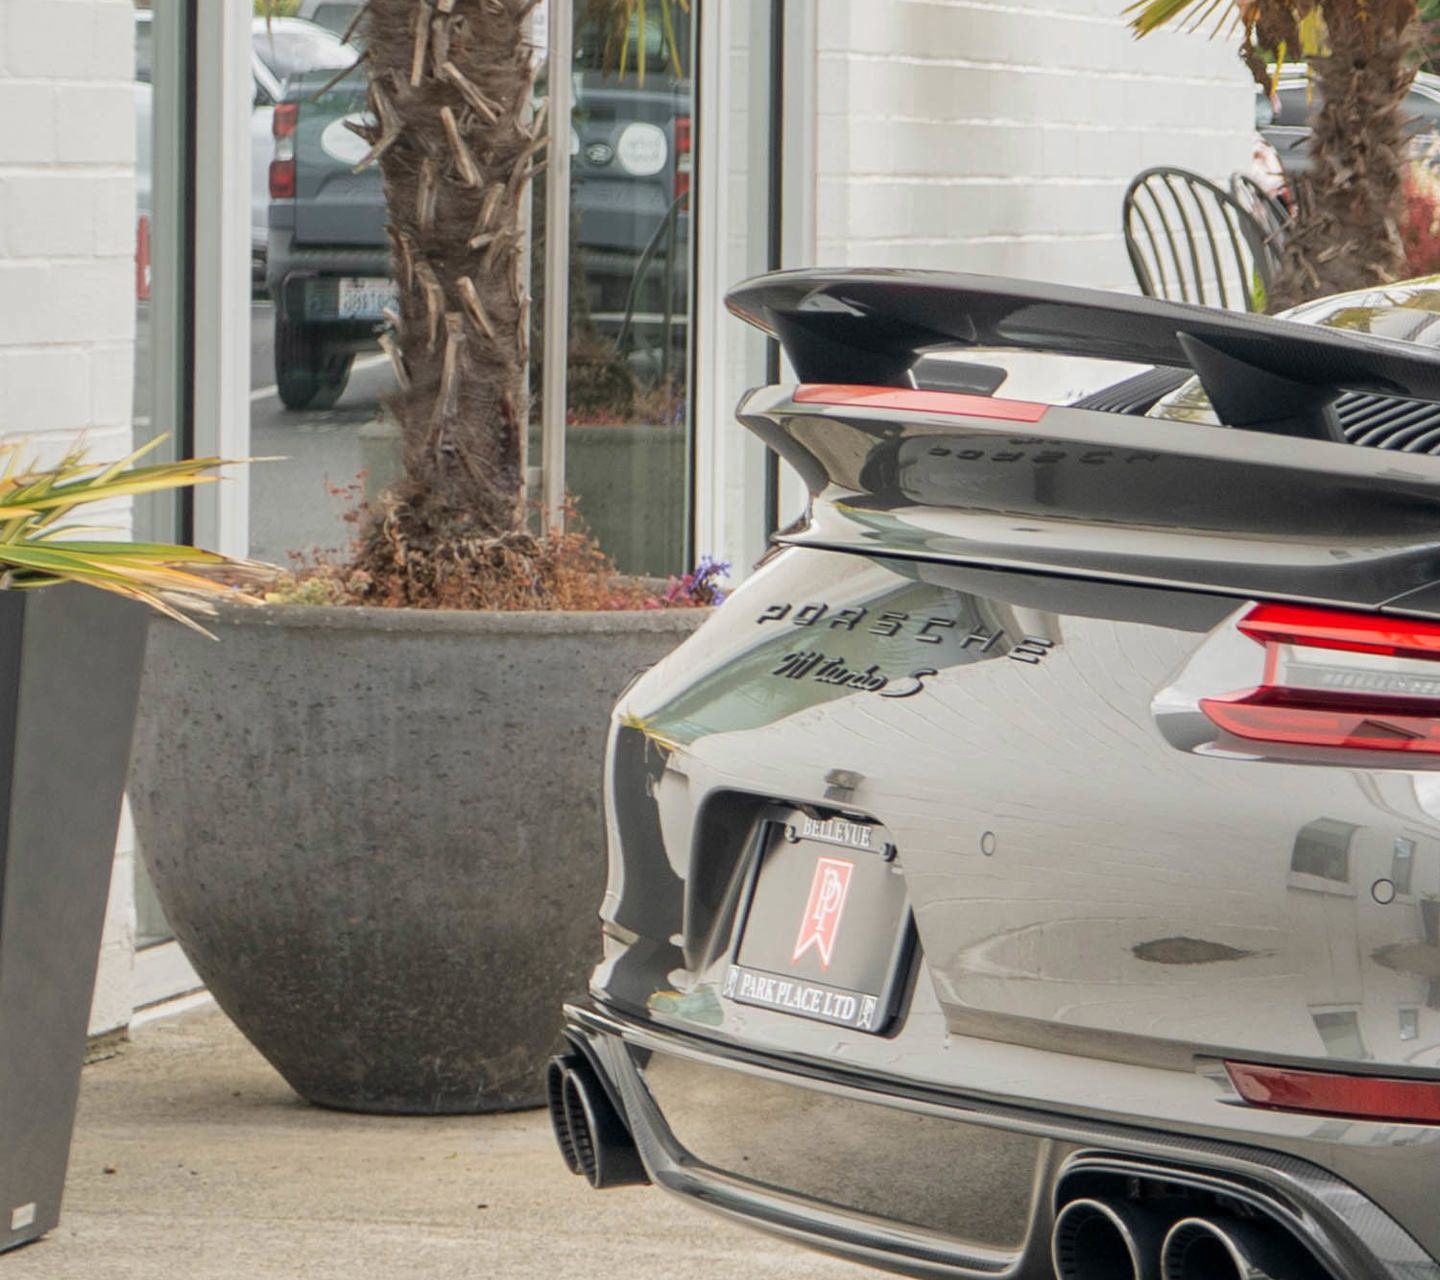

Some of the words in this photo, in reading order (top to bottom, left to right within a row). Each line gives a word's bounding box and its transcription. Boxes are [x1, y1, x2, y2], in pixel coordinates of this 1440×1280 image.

[757, 602, 1054, 665] PORSCHE
[772, 651, 823, 679] 911
[816, 656, 888, 692] Turbo
[879, 668, 938, 698] S
[803, 817, 872, 848] BELLEVUE
[740, 973, 776, 1003] PARK
[775, 981, 824, 1014] PLACE
[822, 992, 857, 1020] LTD
